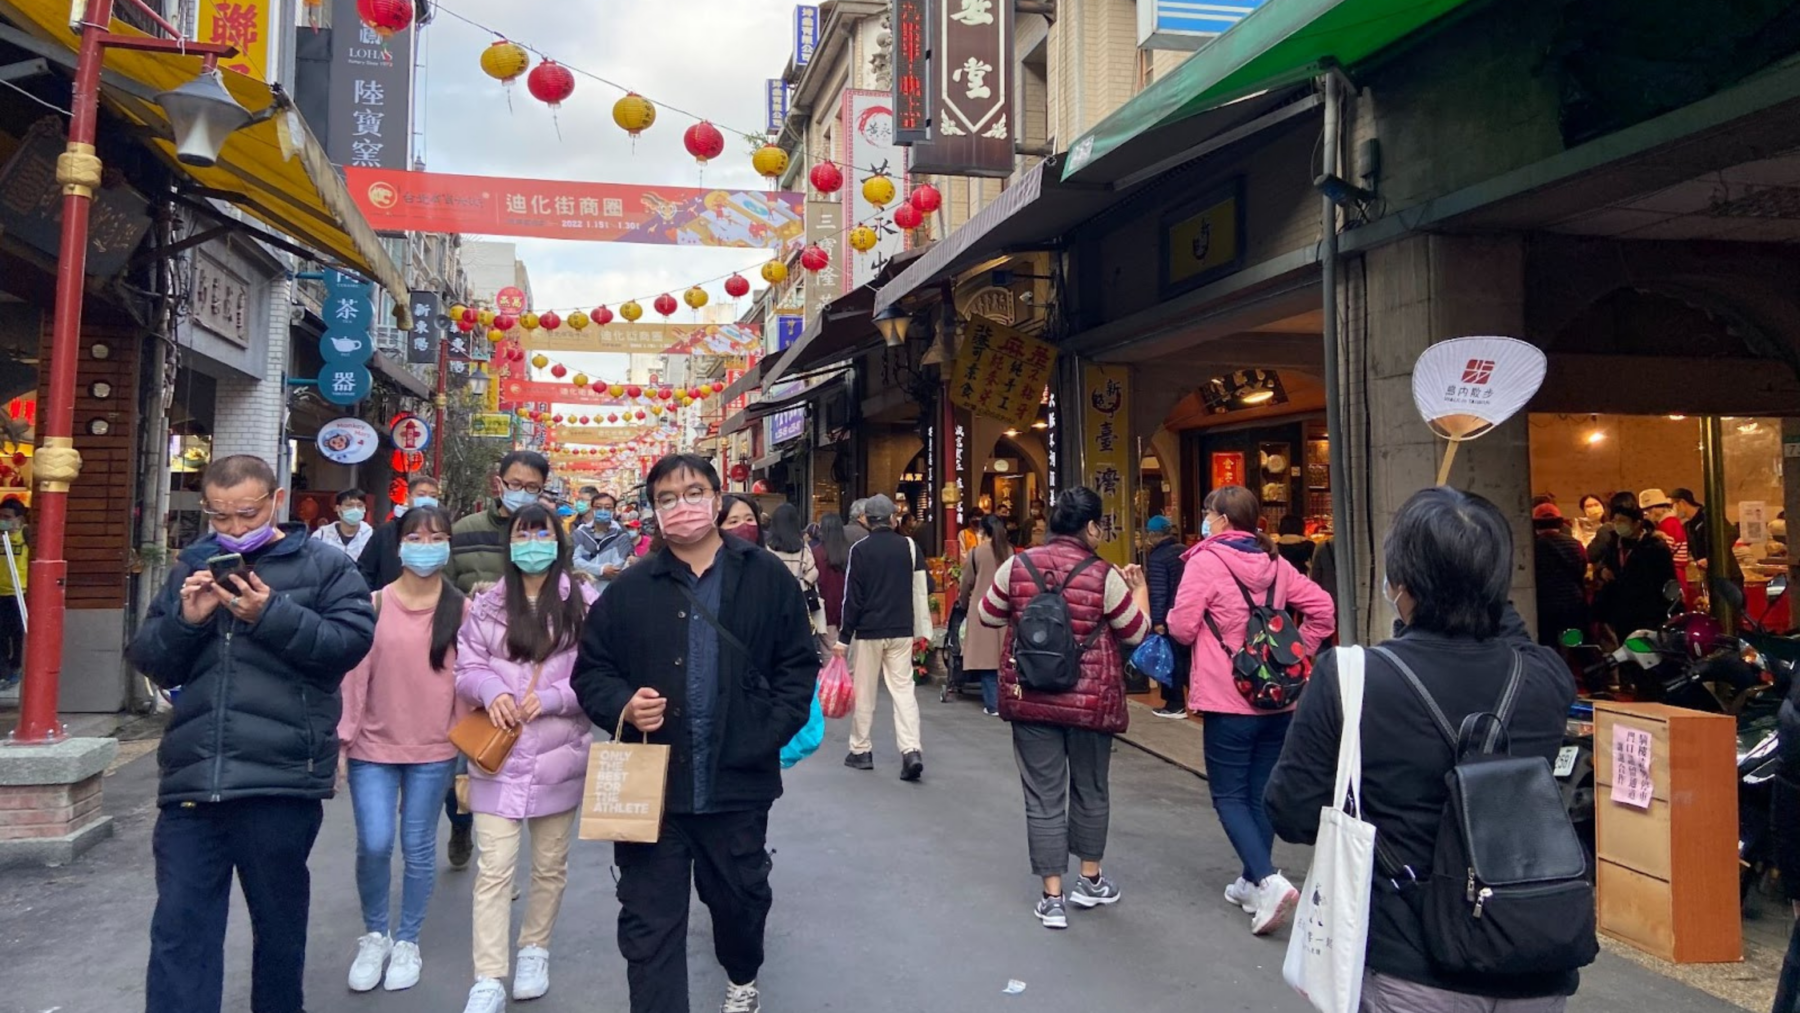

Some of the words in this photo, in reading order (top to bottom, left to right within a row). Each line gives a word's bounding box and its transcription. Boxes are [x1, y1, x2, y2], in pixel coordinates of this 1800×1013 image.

[210, 0, 259, 75] 聯
[349, 47, 393, 62] LOHAS
[351, 80, 385, 168] 陸寶窯
[506, 193, 623, 218] 迪化街商圈
[561, 219, 583, 229] 2022
[336, 299, 359, 320] 茶
[332, 372, 357, 392] 器
[600, 750, 632, 761] ONLY
[599, 761, 624, 772] THE
[598, 772, 629, 782] BEST
[596, 781, 622, 792] FOR
[594, 792, 619, 802] THE
[593, 802, 649, 814] ATHLETE
